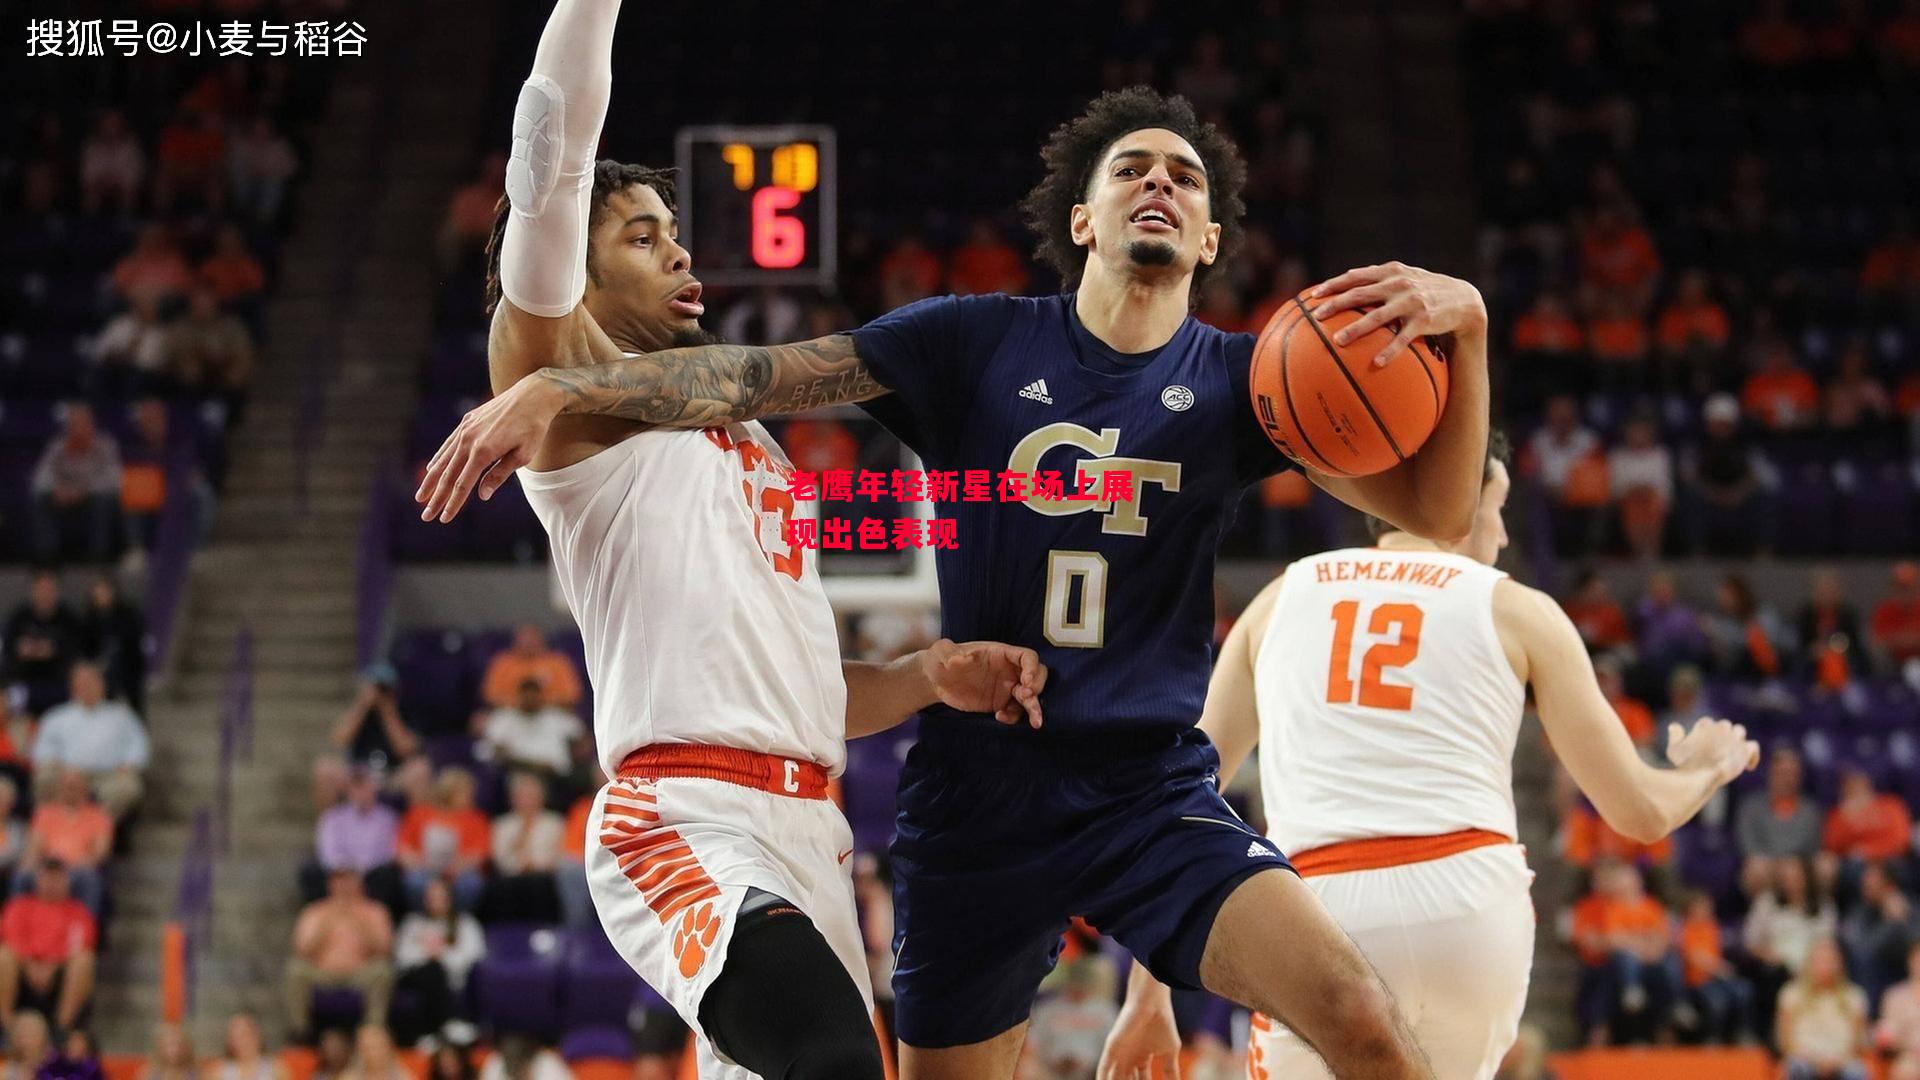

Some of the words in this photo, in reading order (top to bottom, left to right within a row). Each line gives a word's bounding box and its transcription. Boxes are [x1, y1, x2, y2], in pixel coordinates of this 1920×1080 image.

[753, 186, 804, 268] 6
[792, 378, 824, 400] BE
[1018, 388, 1053, 405] adidas
[1008, 422, 1182, 537] GT
[1043, 550, 1109, 649] 0
[1315, 561, 1463, 589] HEMENWAY
[1326, 600, 1424, 712] 12
[783, 759, 800, 793] C
